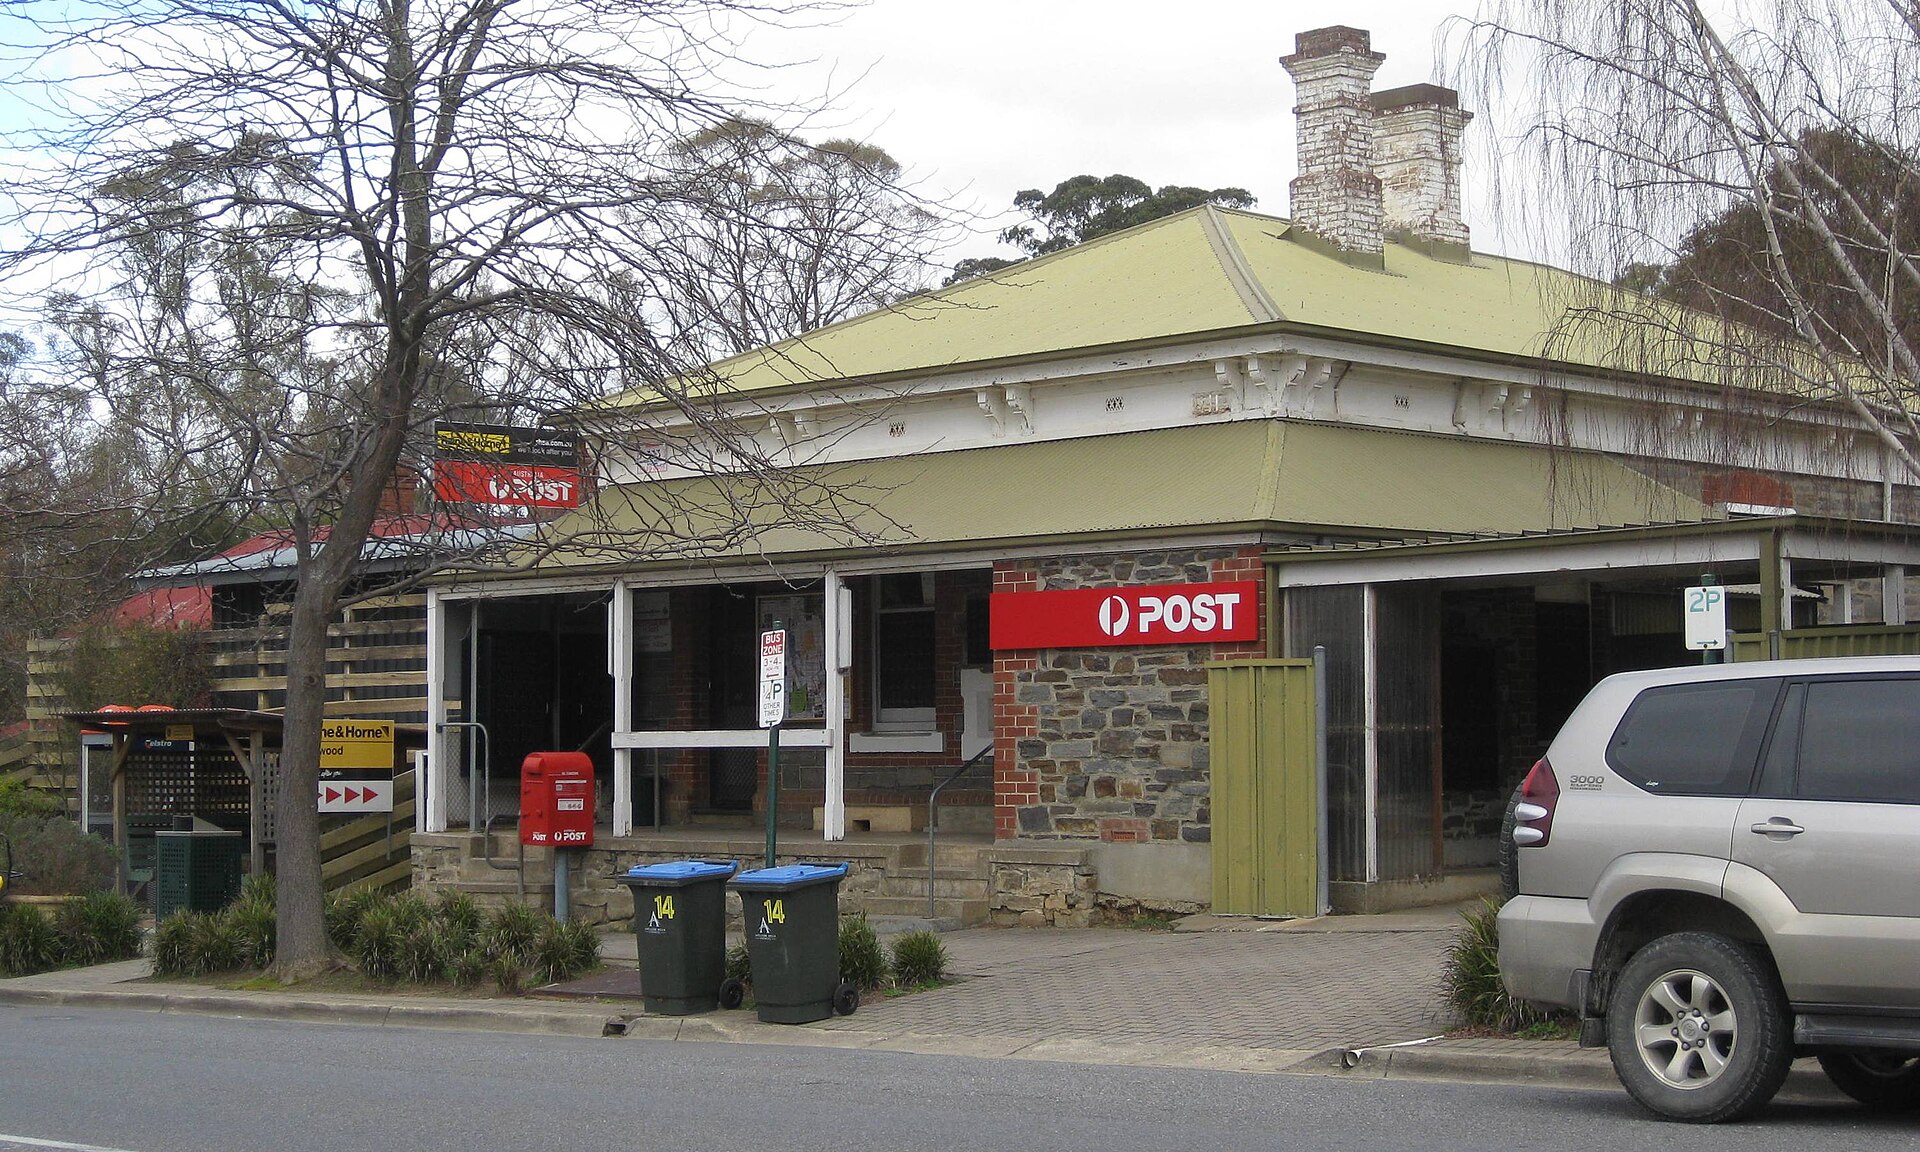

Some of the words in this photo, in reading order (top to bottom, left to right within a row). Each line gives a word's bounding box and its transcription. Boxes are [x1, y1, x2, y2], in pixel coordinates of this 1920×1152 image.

[561, 449, 573, 457] you
[512, 478, 574, 501] POST
[1690, 590, 1721, 612] 2P
[1139, 593, 1240, 633] POST
[765, 633, 781, 644] BUS
[763, 644, 783, 656] ZONE
[763, 701, 781, 710] OTHER
[764, 709, 780, 717] TIMES
[1570, 775, 1605, 784] 3000
[532, 833, 547, 841] POST
[563, 831, 587, 841] POST
[654, 895, 675, 919] 14
[763, 899, 786, 924] 14
